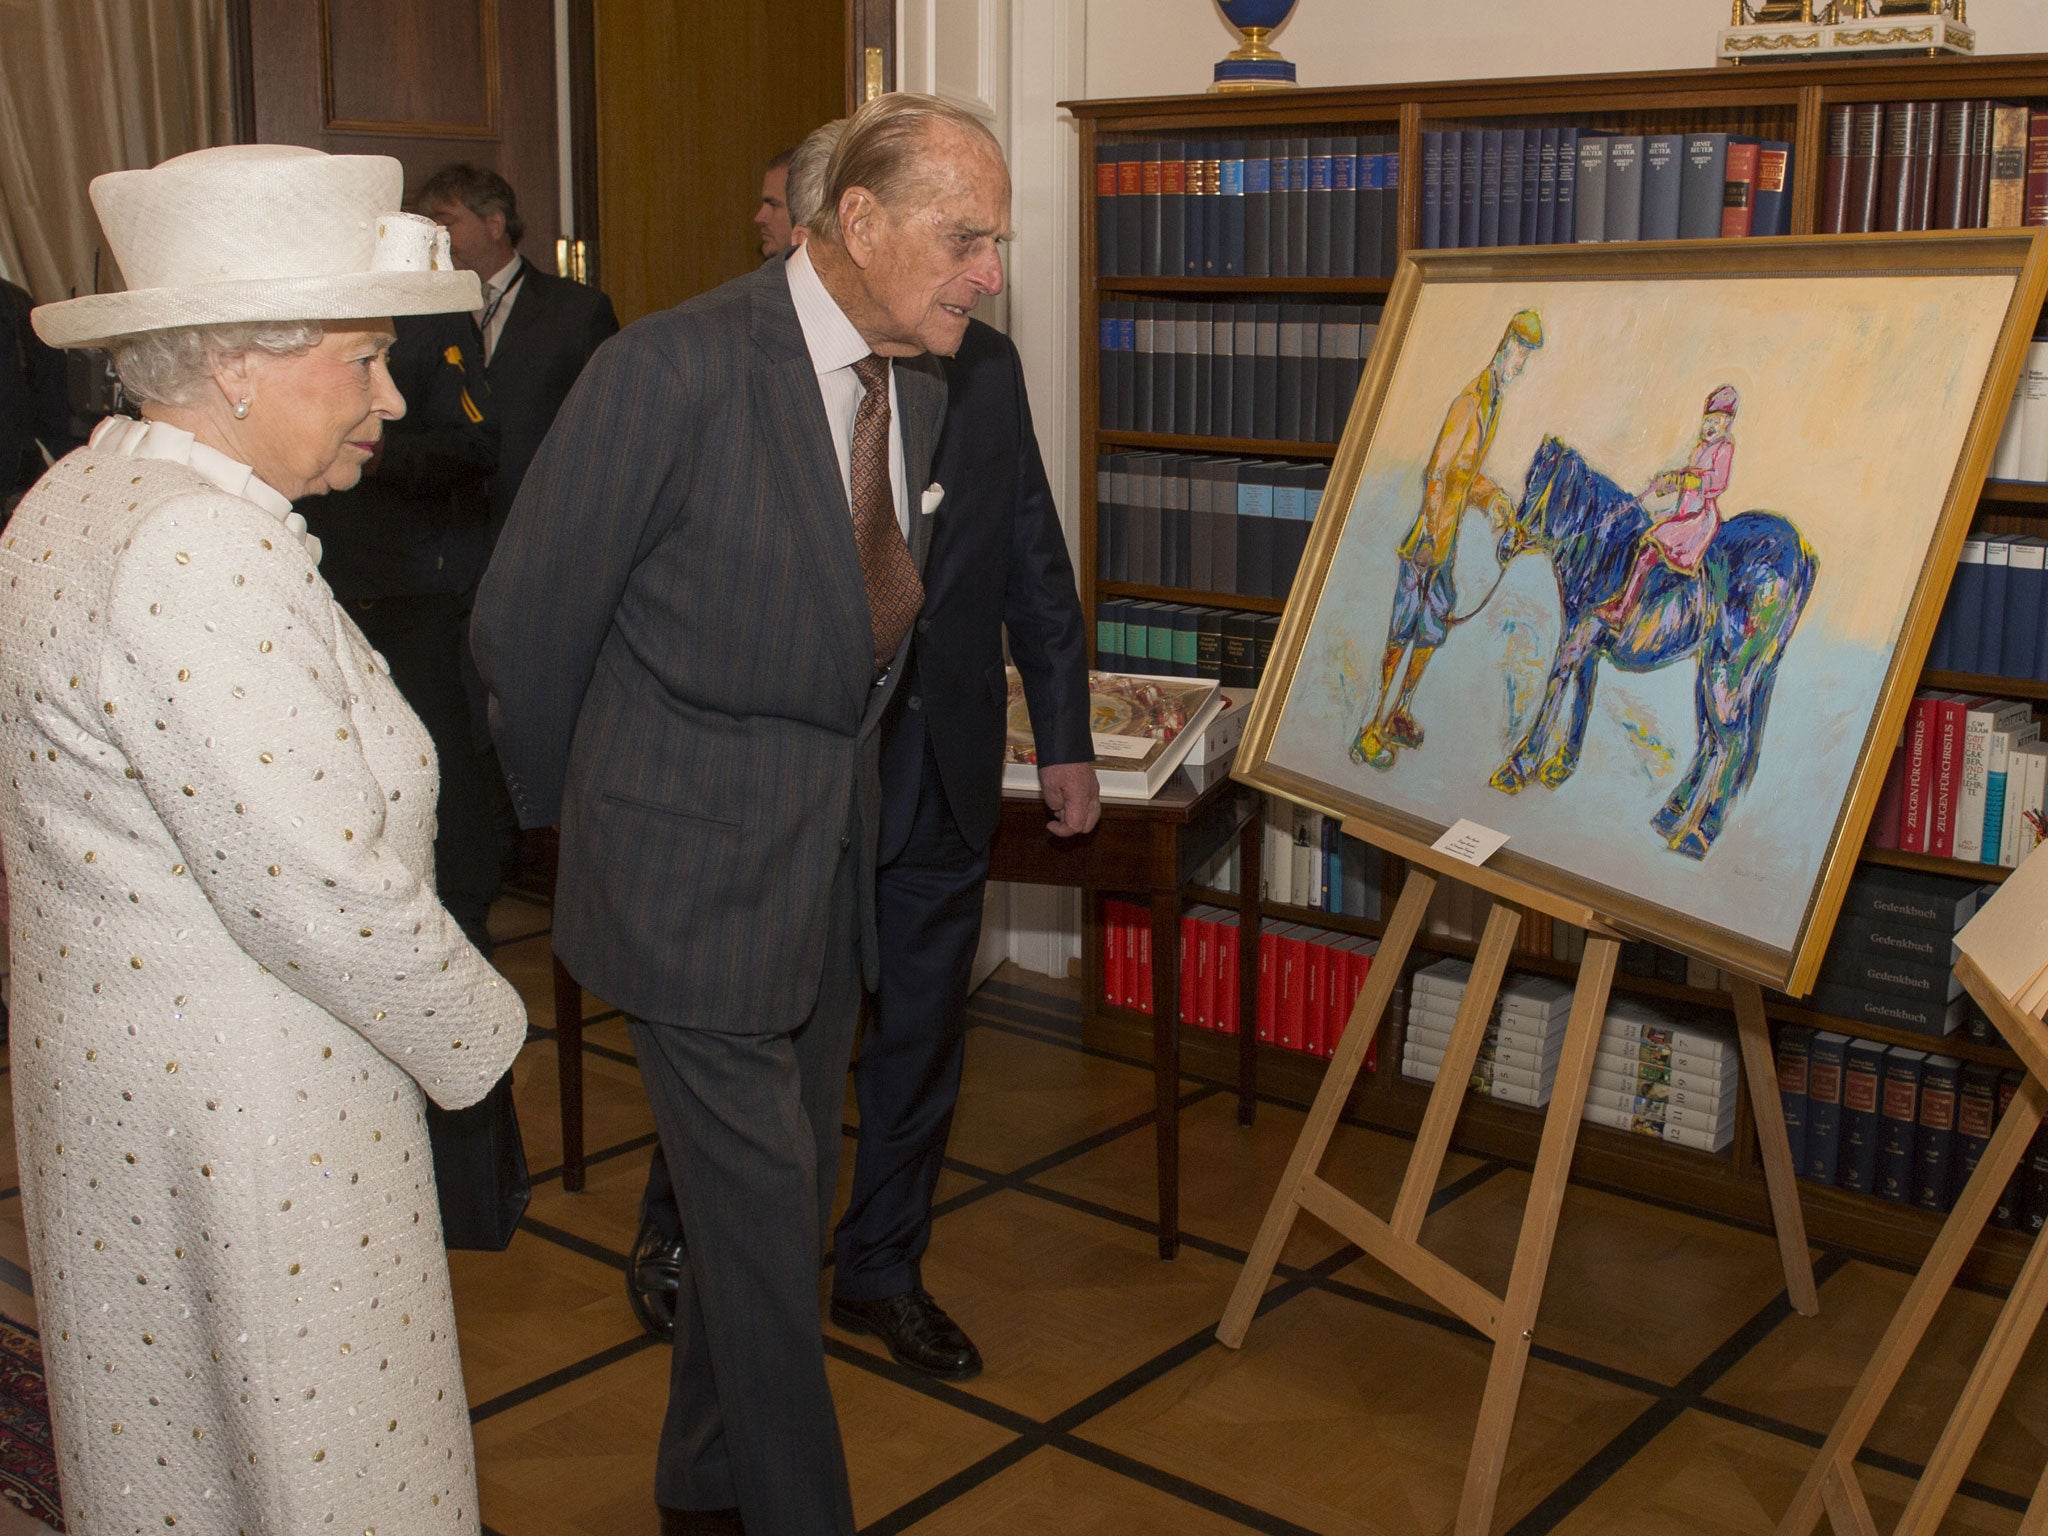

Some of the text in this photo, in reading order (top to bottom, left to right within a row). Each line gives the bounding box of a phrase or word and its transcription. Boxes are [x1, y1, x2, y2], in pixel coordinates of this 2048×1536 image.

[1912, 720, 1925, 768] CHRISTUS
[1910, 769, 1920, 789] FÜR
[1937, 711, 1954, 832] ZEUGEN FÜR CHRISTUS II
[1967, 788, 1977, 796] TE
[1908, 789, 1919, 828] ZEUGEN
[1873, 900, 1936, 919] Gedenkbuch
[1871, 933, 1933, 953] Gedenkbuch
[1867, 969, 1930, 989] Gedenkbuch
[1864, 1003, 1927, 1023] Gedenkbuch
[1680, 1040, 1688, 1048] 7
[1676, 1092, 1685, 1104] 10
[1673, 1110, 1683, 1121] 11
[1671, 1129, 1680, 1140] 12
